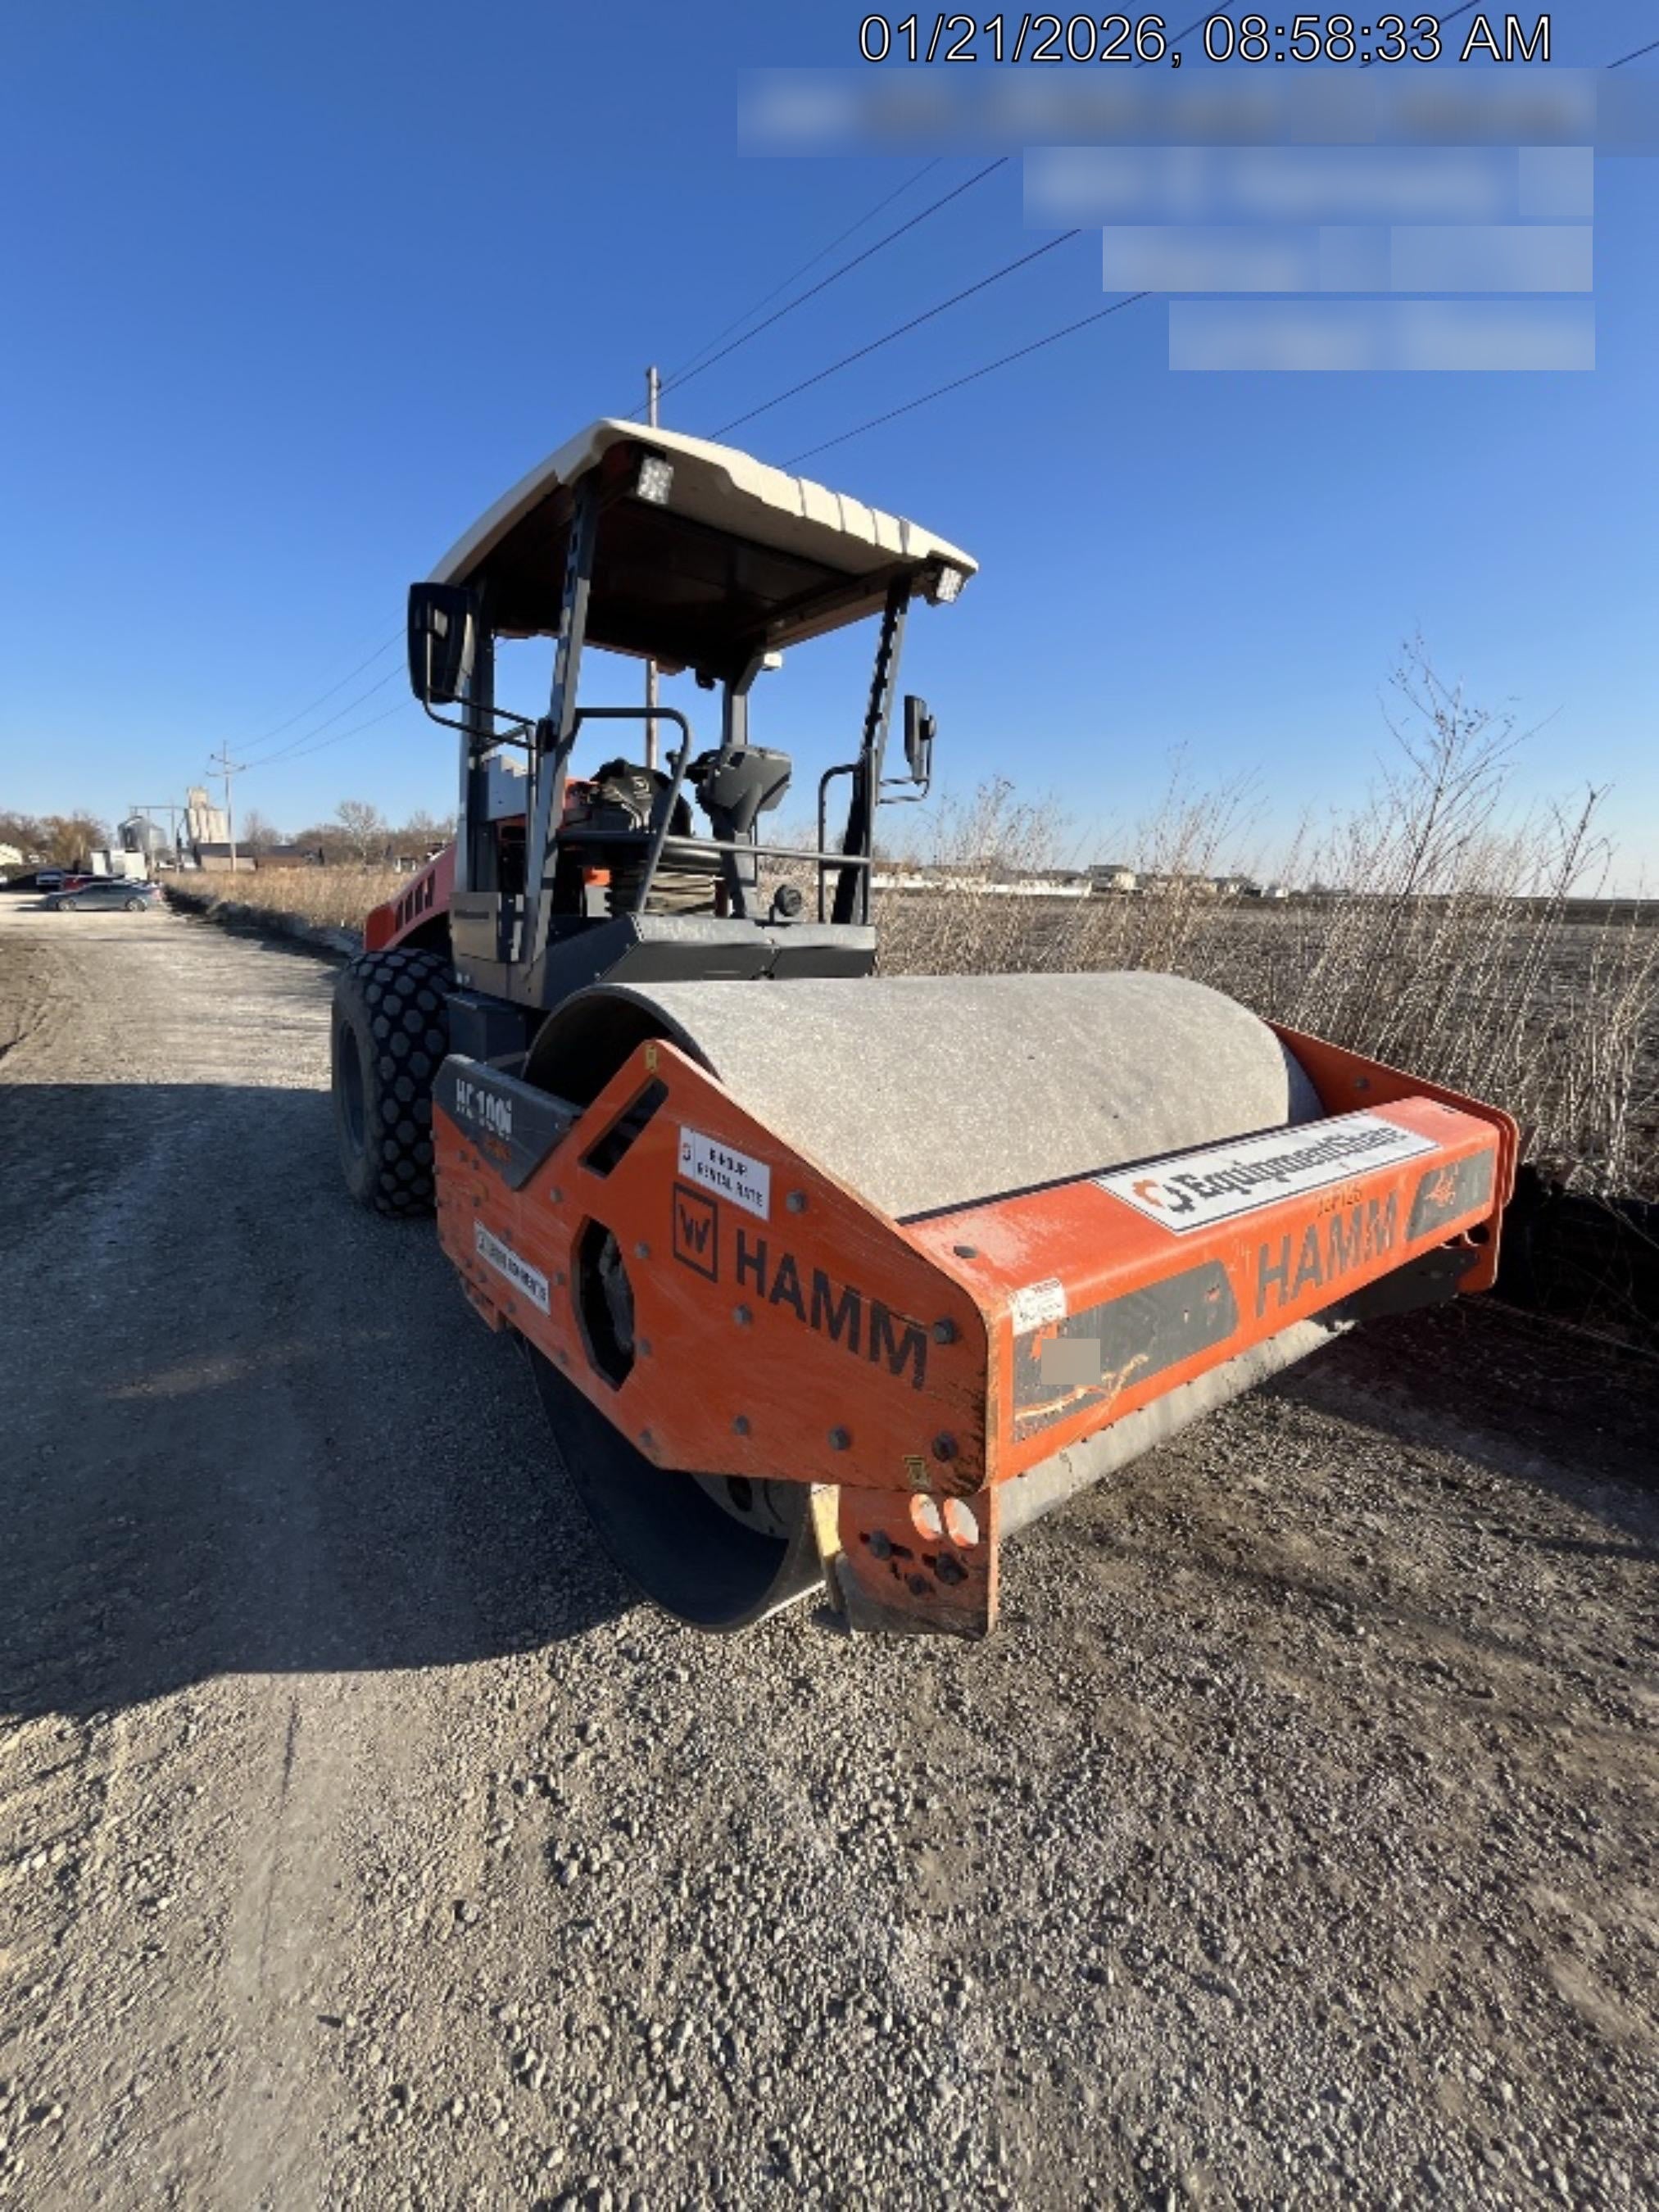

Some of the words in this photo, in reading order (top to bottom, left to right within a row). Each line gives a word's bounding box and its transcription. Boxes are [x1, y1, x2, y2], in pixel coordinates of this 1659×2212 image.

[1169, 1126, 1408, 1199] EquipmentShare
[737, 1228, 927, 1391] HAMM
[1255, 1190, 1398, 1319] HAMM
